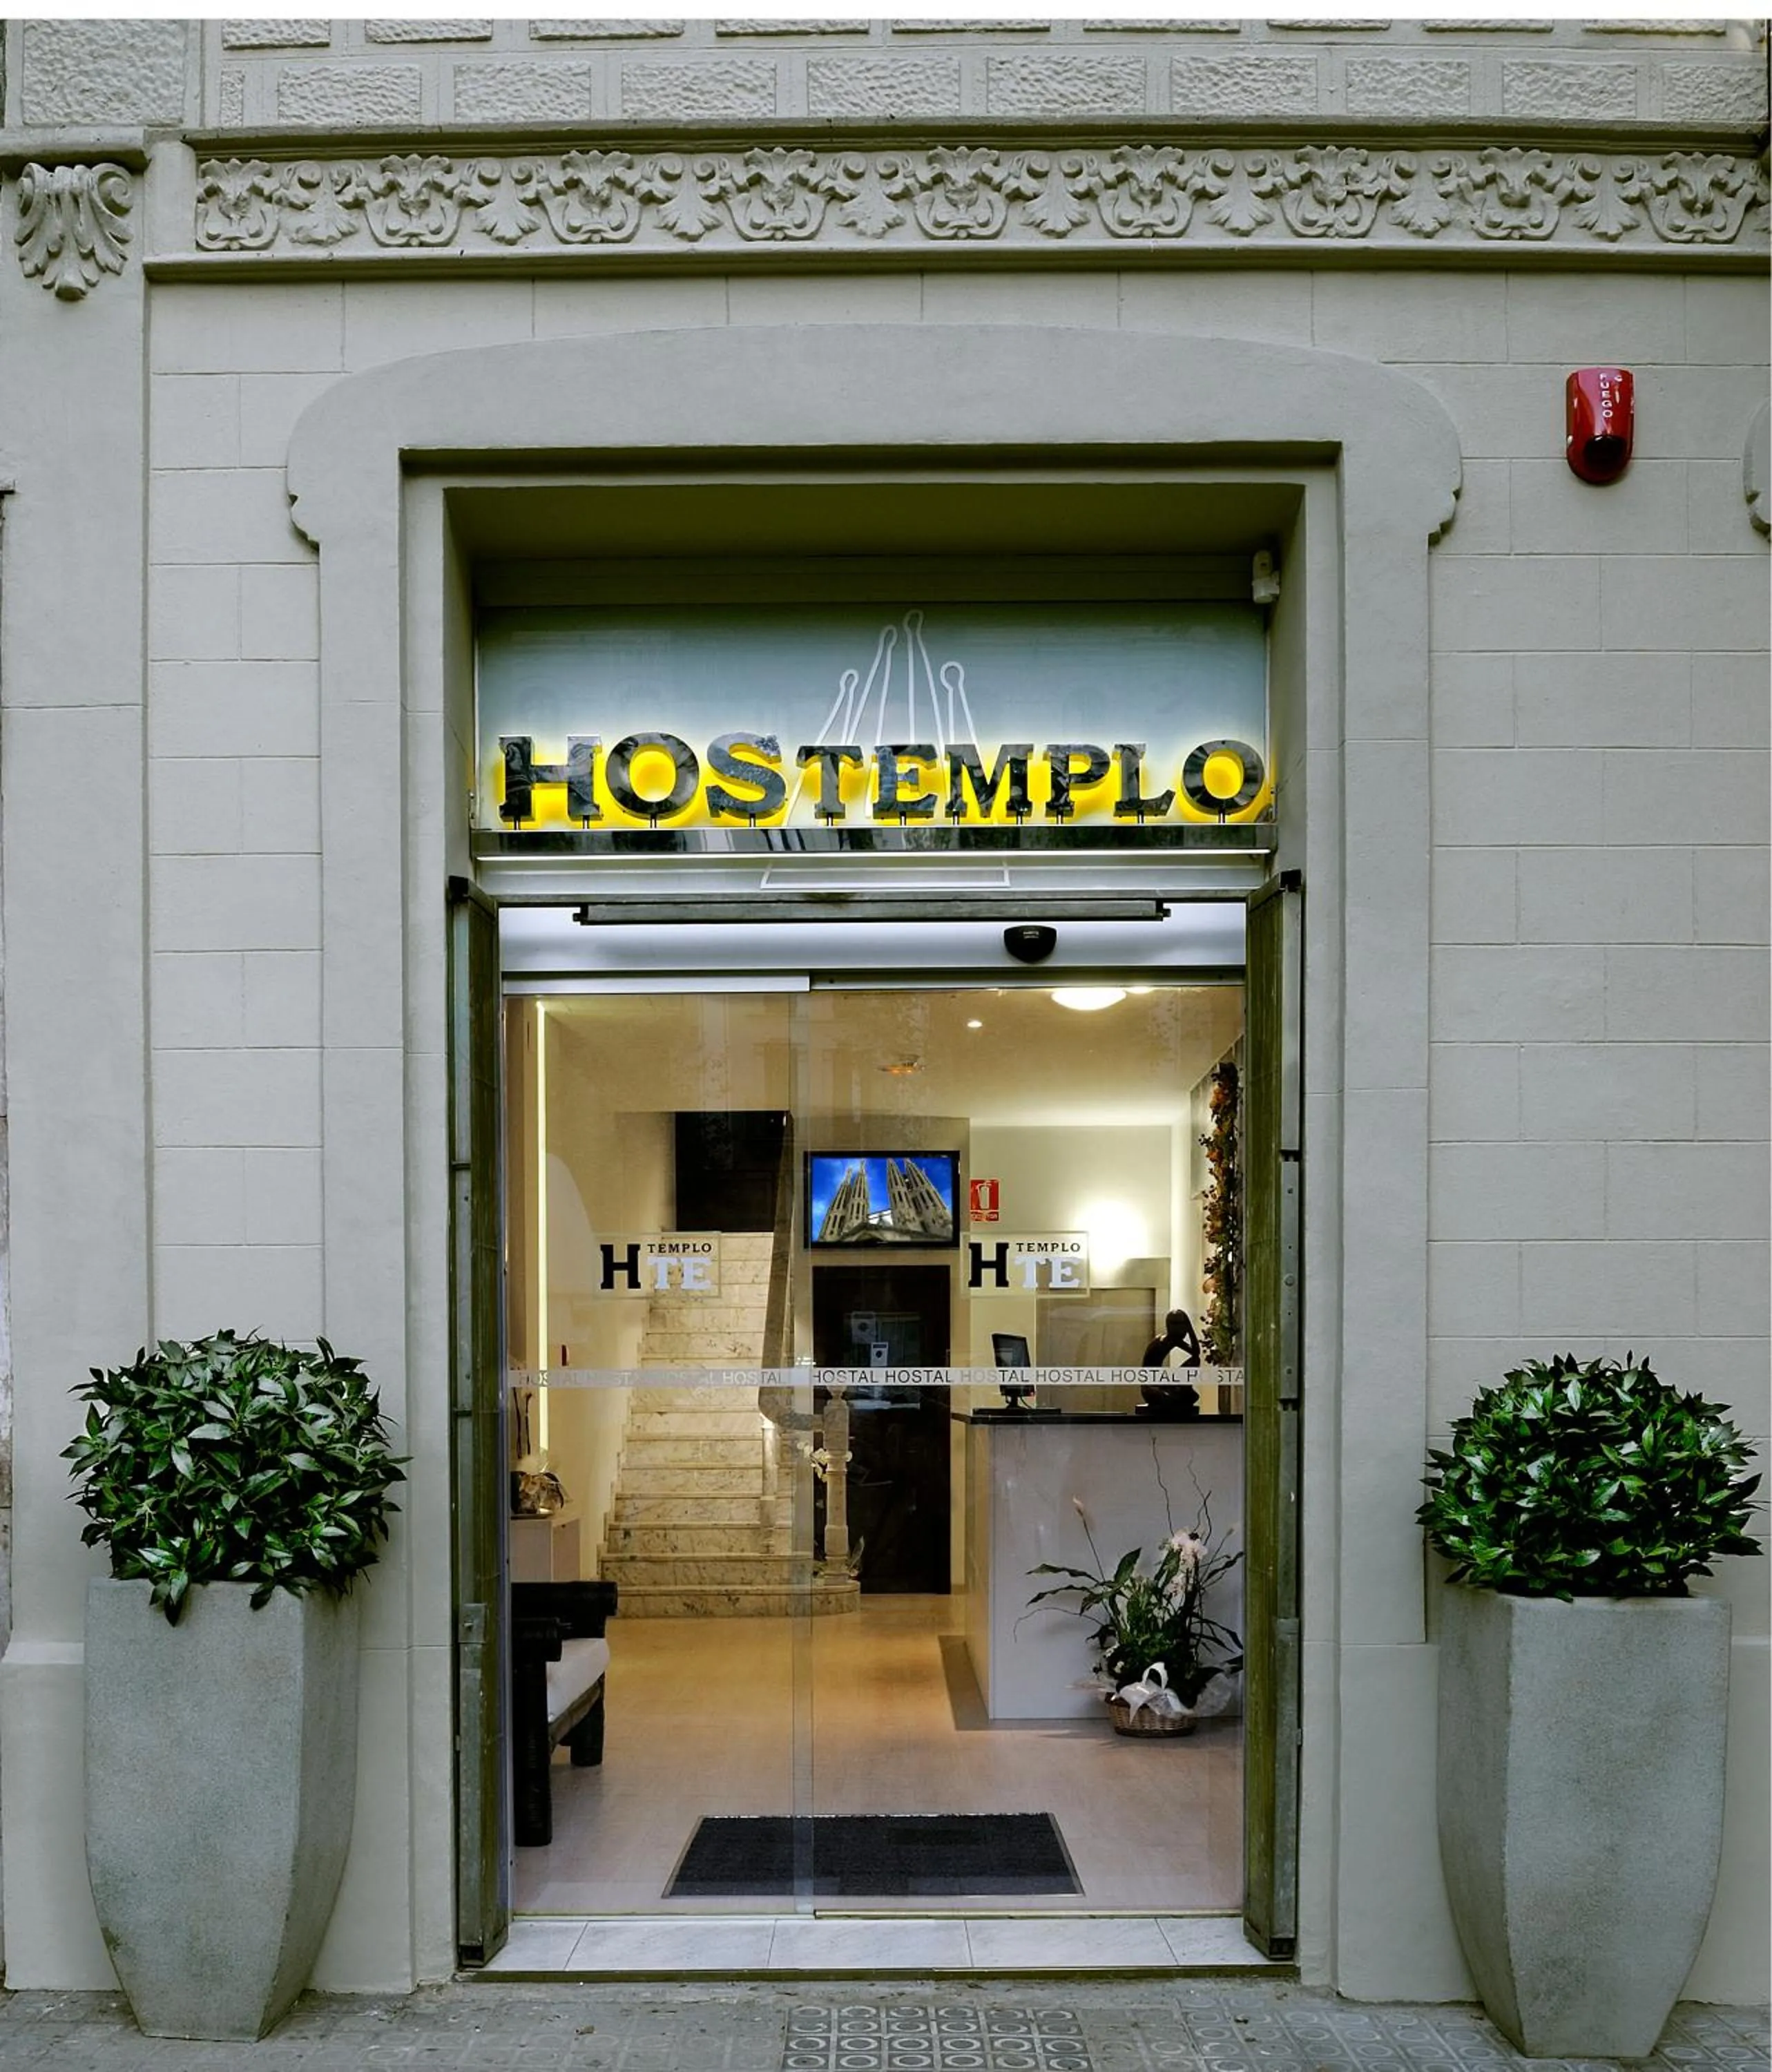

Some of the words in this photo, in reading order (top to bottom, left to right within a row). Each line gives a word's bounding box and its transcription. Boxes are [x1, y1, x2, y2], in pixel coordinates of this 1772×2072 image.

[1599, 373, 1613, 418] FUEGO
[498, 732, 1266, 821] HOSTEMPLO
[648, 1243, 712, 1254] TEMPLO
[1016, 1243, 1081, 1252] TEMPLO
[813, 1370, 878, 1383] HOSTAL
[885, 1370, 952, 1383] HOSTAL
[961, 1370, 1029, 1383] HOSTAL
[1035, 1370, 1106, 1383] HOSTAL
[1111, 1370, 1182, 1383] HOSTAL
